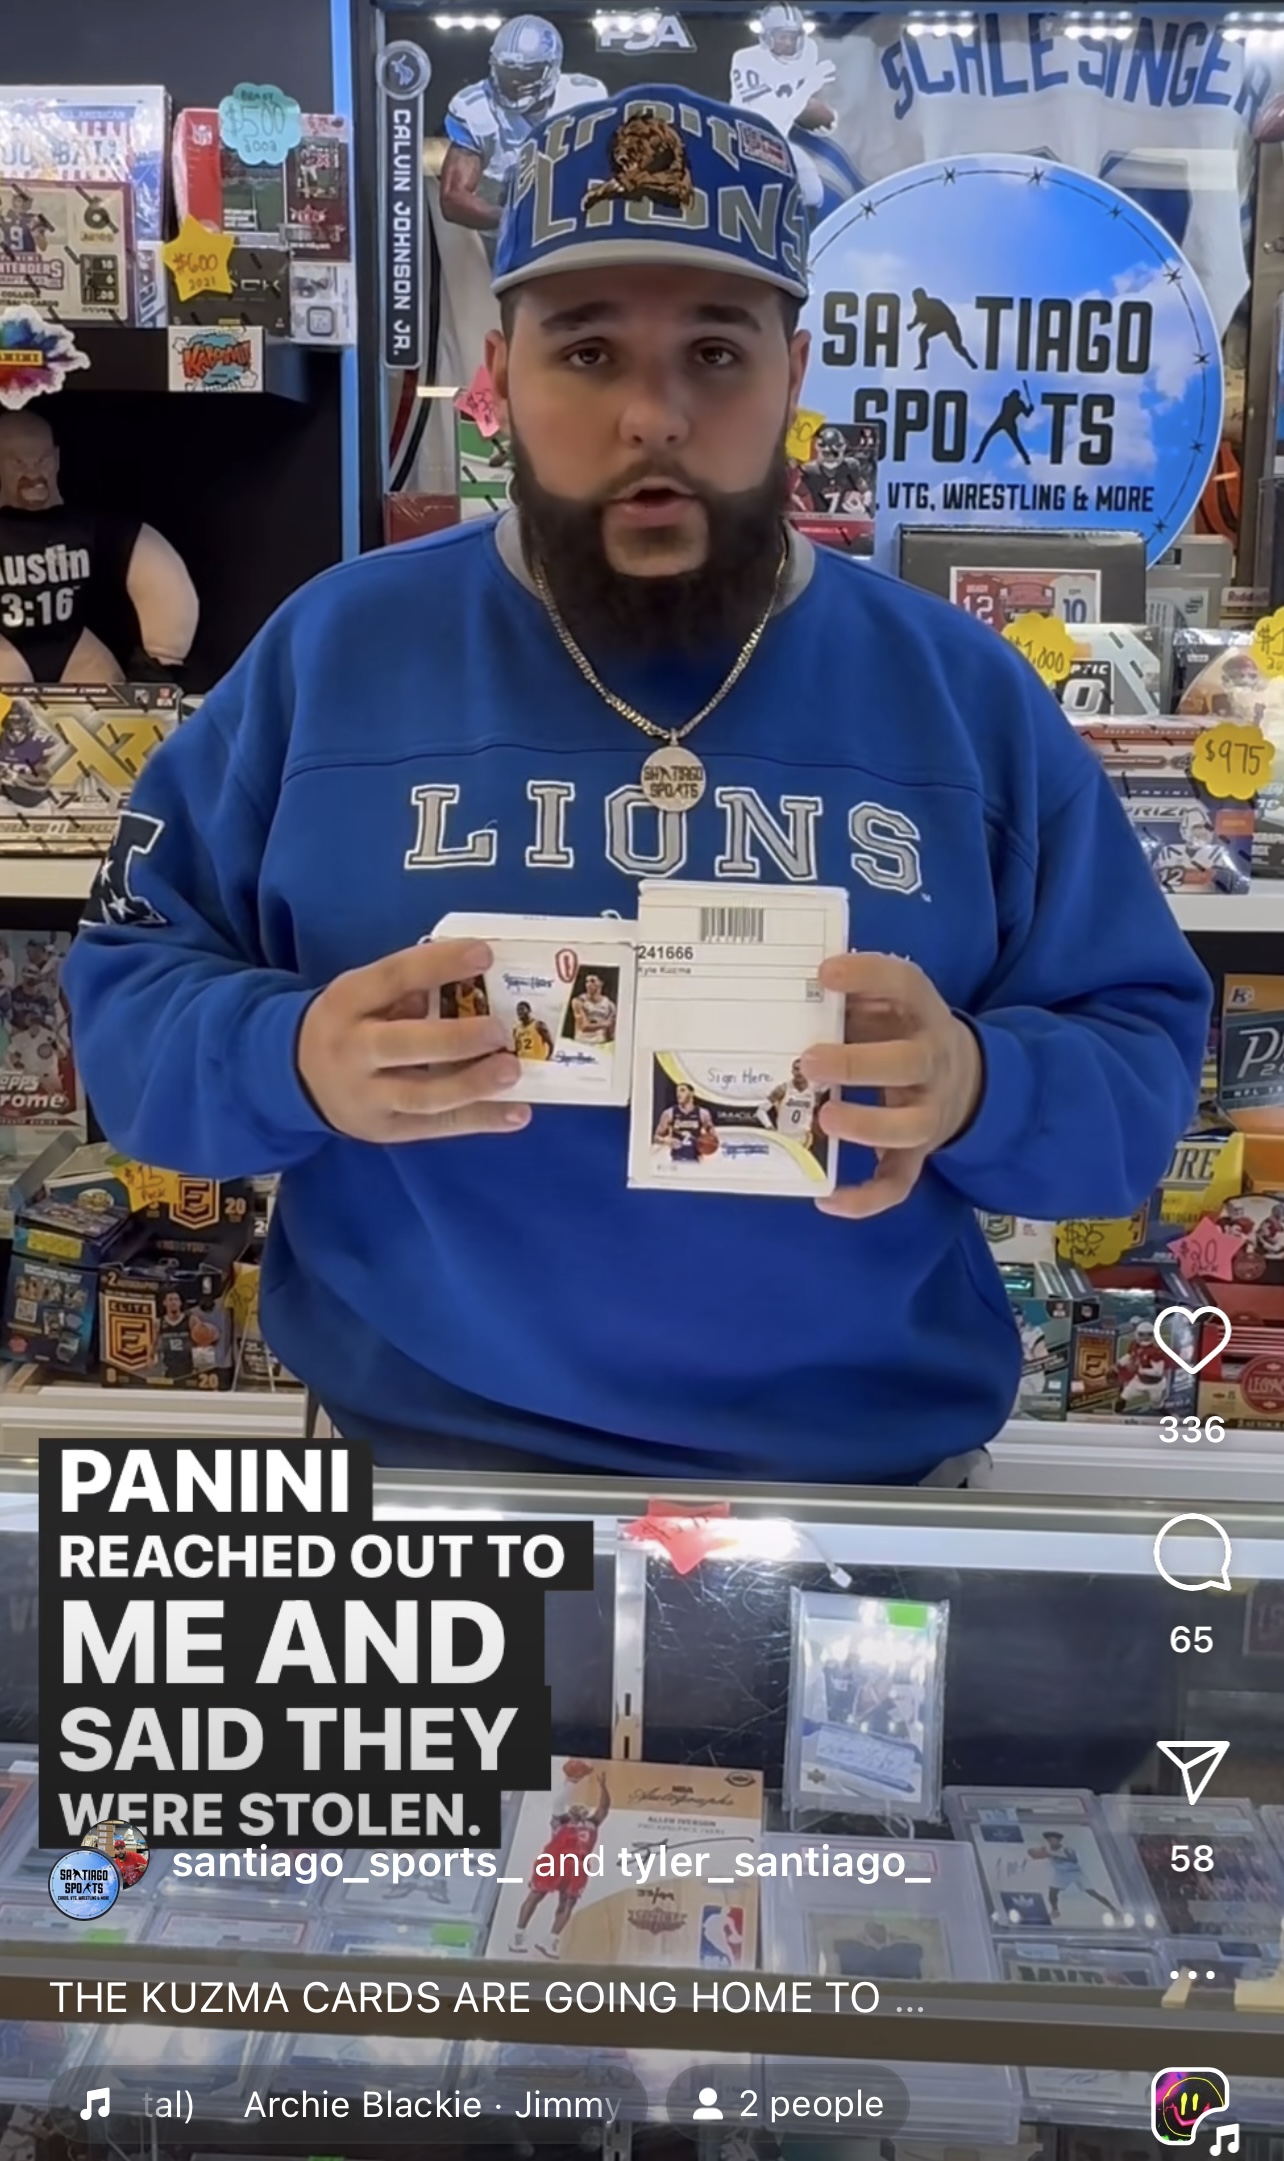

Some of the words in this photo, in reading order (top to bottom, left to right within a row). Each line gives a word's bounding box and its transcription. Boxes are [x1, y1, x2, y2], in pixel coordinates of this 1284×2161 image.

[223, 103, 285, 138] $500
[393, 109, 411, 191] CALVIN
[393, 200, 411, 311] JOHNSON
[393, 315, 411, 356] JR.
[887, 482, 935, 511] VTG,
[943, 483, 1066, 511] WRESTLING
[1073, 485, 1088, 511] &
[1096, 486, 1155, 512] MORE
[1, 587, 74, 627] 3:16
[962, 595, 994, 625] 12
[1062, 598, 1087, 623] 10
[1070, 664, 1109, 675] PTIC
[1205, 740, 1265, 775] $975
[404, 780, 922, 895] LIONS
[637, 944, 695, 961] 241666
[707, 1067, 737, 1090] Sign
[0, 1092, 65, 1109] rome
[791, 1109, 801, 1125] 0
[225, 1196, 247, 1215] 20
[1180, 1238, 1217, 1265] $20
[110, 1301, 150, 1314] ELITE
[169, 1338, 184, 1351] 12
